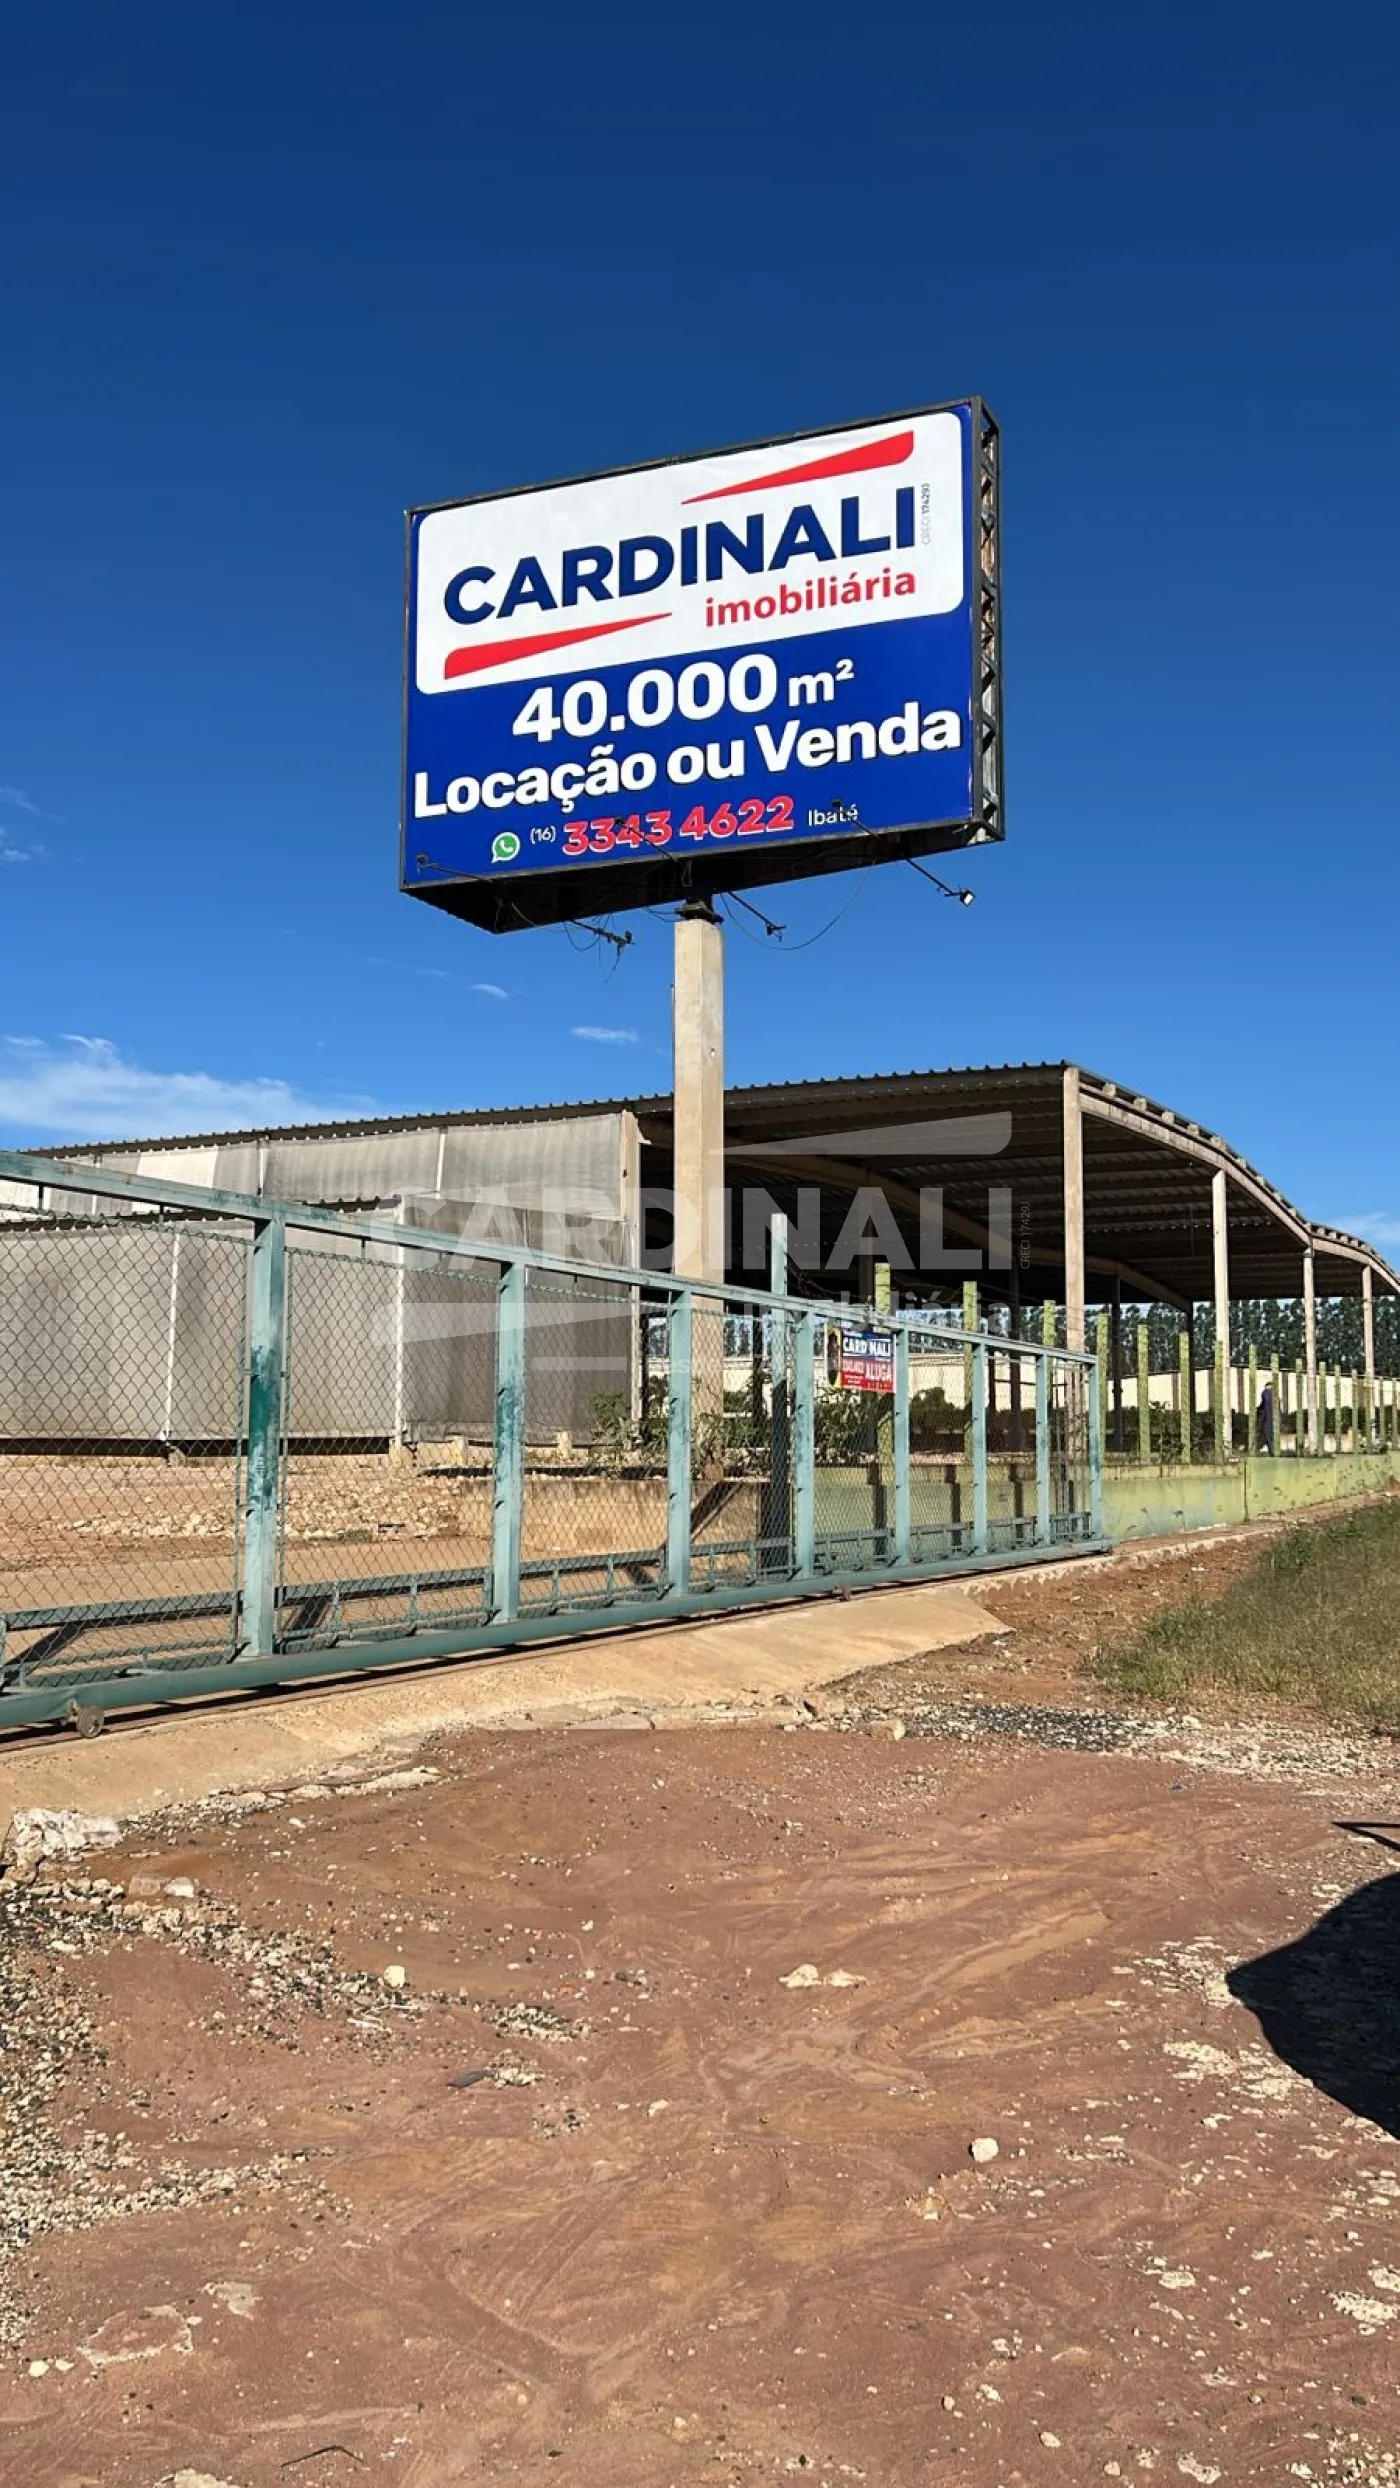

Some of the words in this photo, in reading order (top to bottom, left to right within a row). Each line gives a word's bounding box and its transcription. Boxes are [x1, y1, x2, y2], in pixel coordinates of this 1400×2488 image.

[444, 487, 915, 625] CARDINALI
[705, 567, 916, 627] imobiliária
[512, 653, 777, 742] 40.000
[788, 659, 854, 707] m²
[414, 744, 657, 818] Locação
[666, 740, 744, 784] ou
[754, 701, 961, 773] Venda
[530, 826, 556, 844] (16)
[562, 810, 672, 856] 3343
[679, 796, 794, 841] 4622
[808, 804, 858, 826] Ibaté
